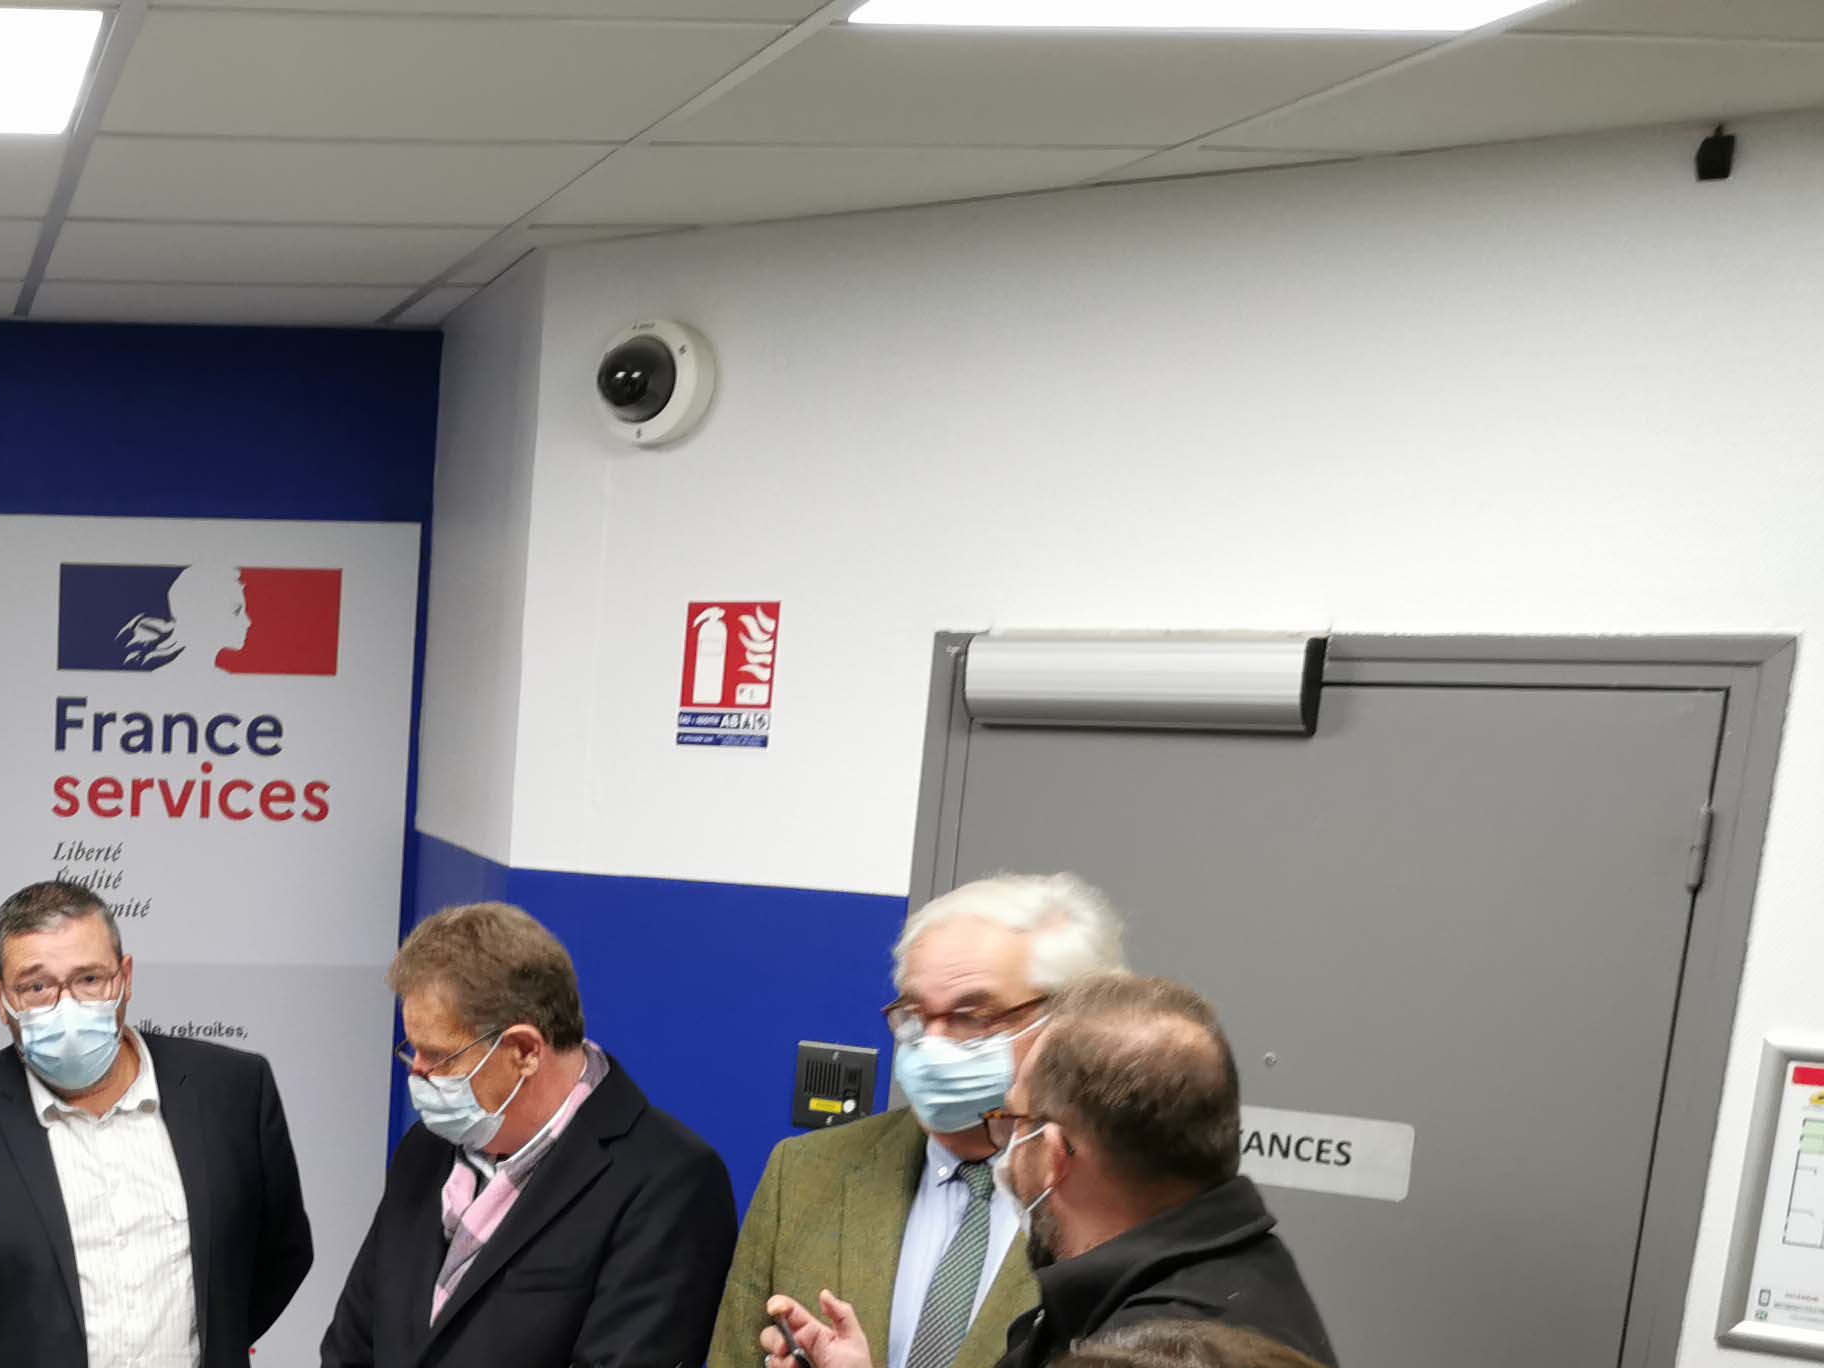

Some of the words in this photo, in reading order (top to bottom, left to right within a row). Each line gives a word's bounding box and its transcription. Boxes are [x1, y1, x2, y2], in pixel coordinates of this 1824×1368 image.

[54, 697, 283, 756] France
[52, 761, 330, 822] services
[52, 840, 124, 862] Liberté
[170, 1021, 248, 1039] retraites,
